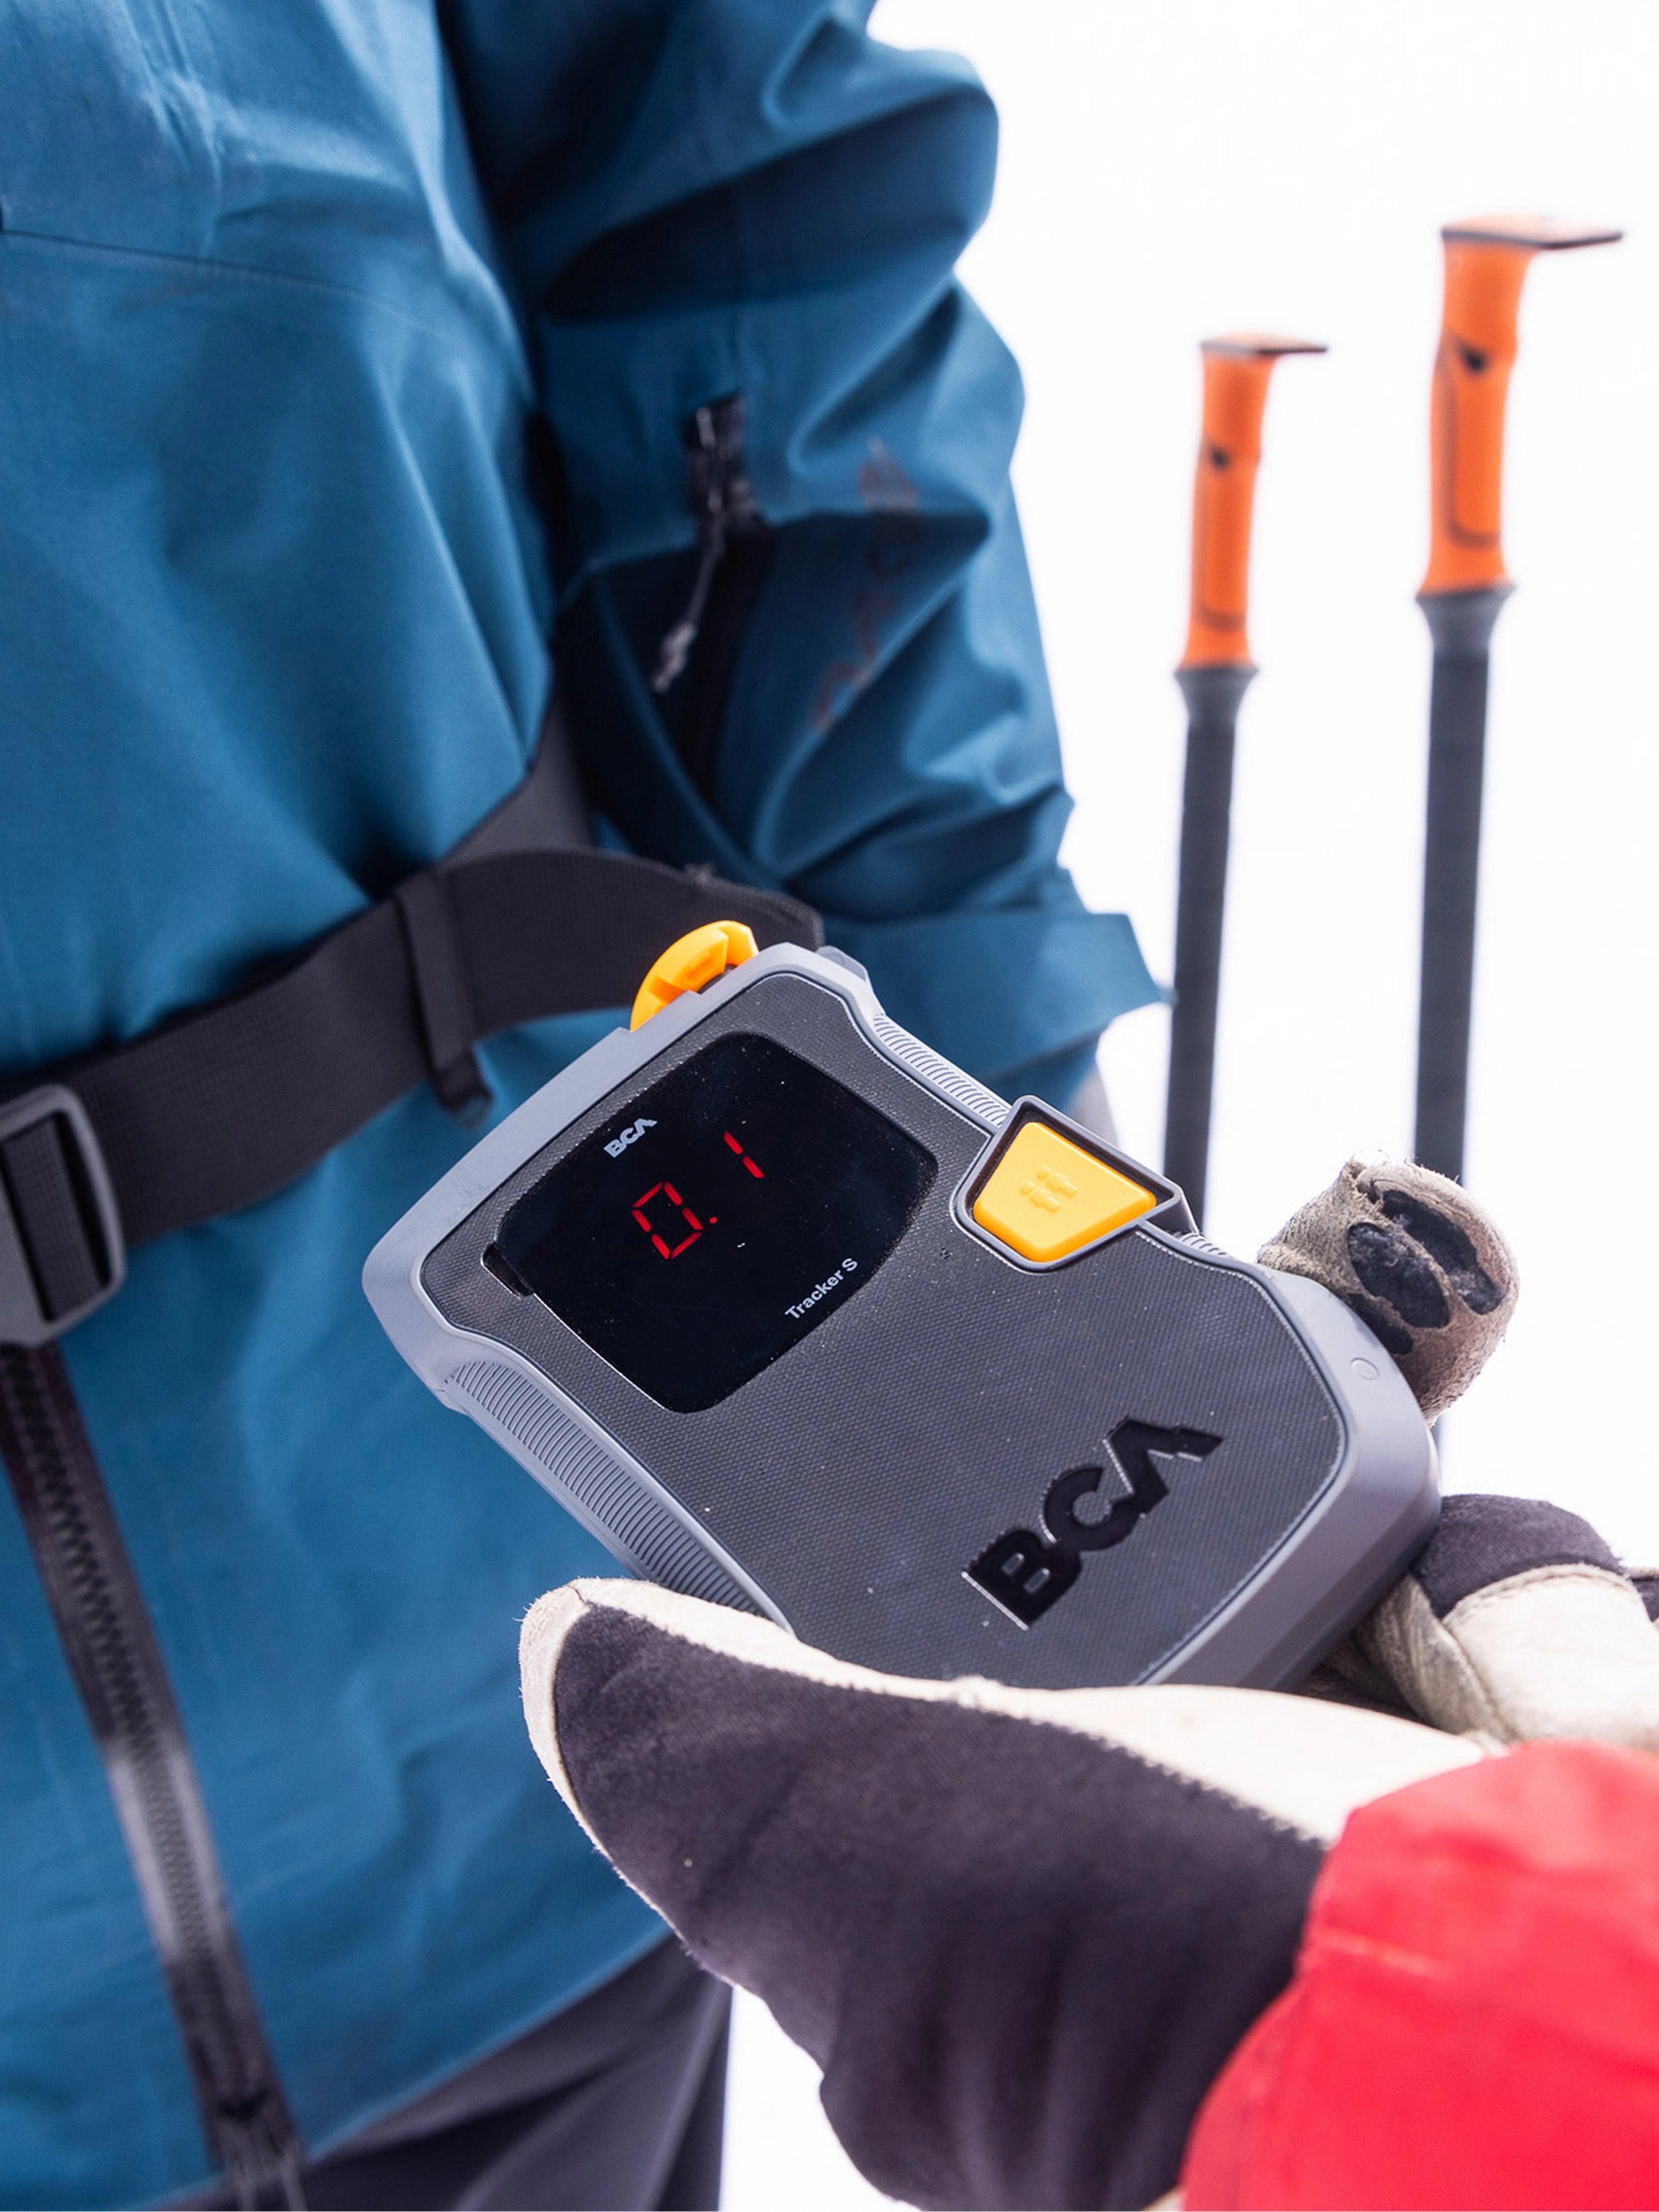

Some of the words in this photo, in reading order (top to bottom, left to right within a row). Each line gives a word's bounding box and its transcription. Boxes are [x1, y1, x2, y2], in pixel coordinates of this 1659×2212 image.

[603, 1117, 657, 1158] BCA
[632, 1131, 764, 1259] 0.1
[785, 1269, 845, 1320] Tracker
[842, 1257, 858, 1272] S
[962, 1415, 1223, 1629] BCA
